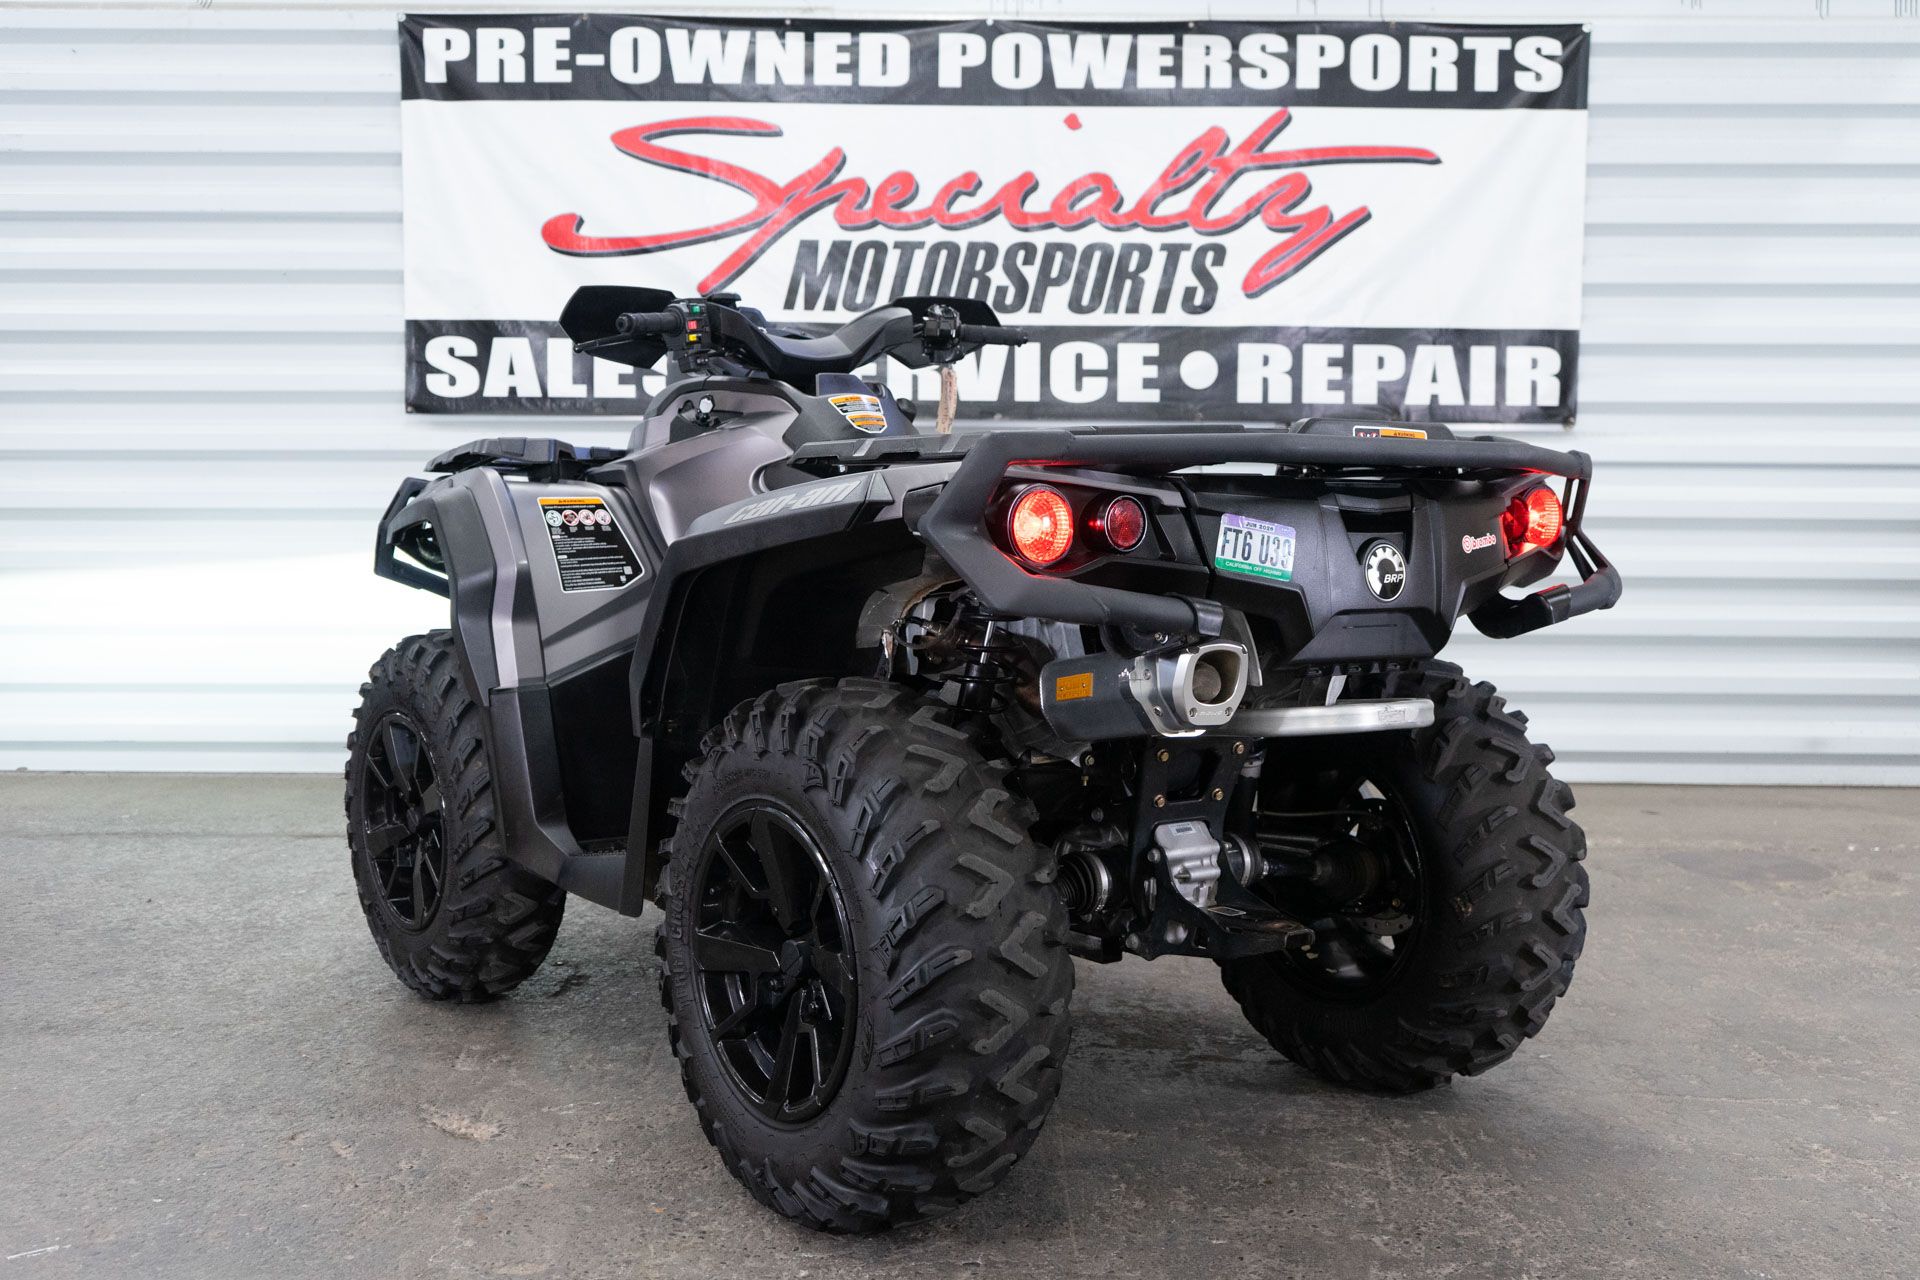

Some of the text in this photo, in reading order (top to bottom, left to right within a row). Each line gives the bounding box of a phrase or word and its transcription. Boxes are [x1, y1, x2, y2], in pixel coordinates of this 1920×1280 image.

[422, 27, 1563, 92] PRE-OWNED POWERSPORTS
[541, 106, 1443, 299] Specialty
[783, 240, 1227, 315] MOTORSPORTS
[425, 336, 668, 398] SALE
[1236, 342, 1561, 406] REPAIR
[1220, 527, 1252, 561] FT6
[1383, 573, 1404, 584] BRP
